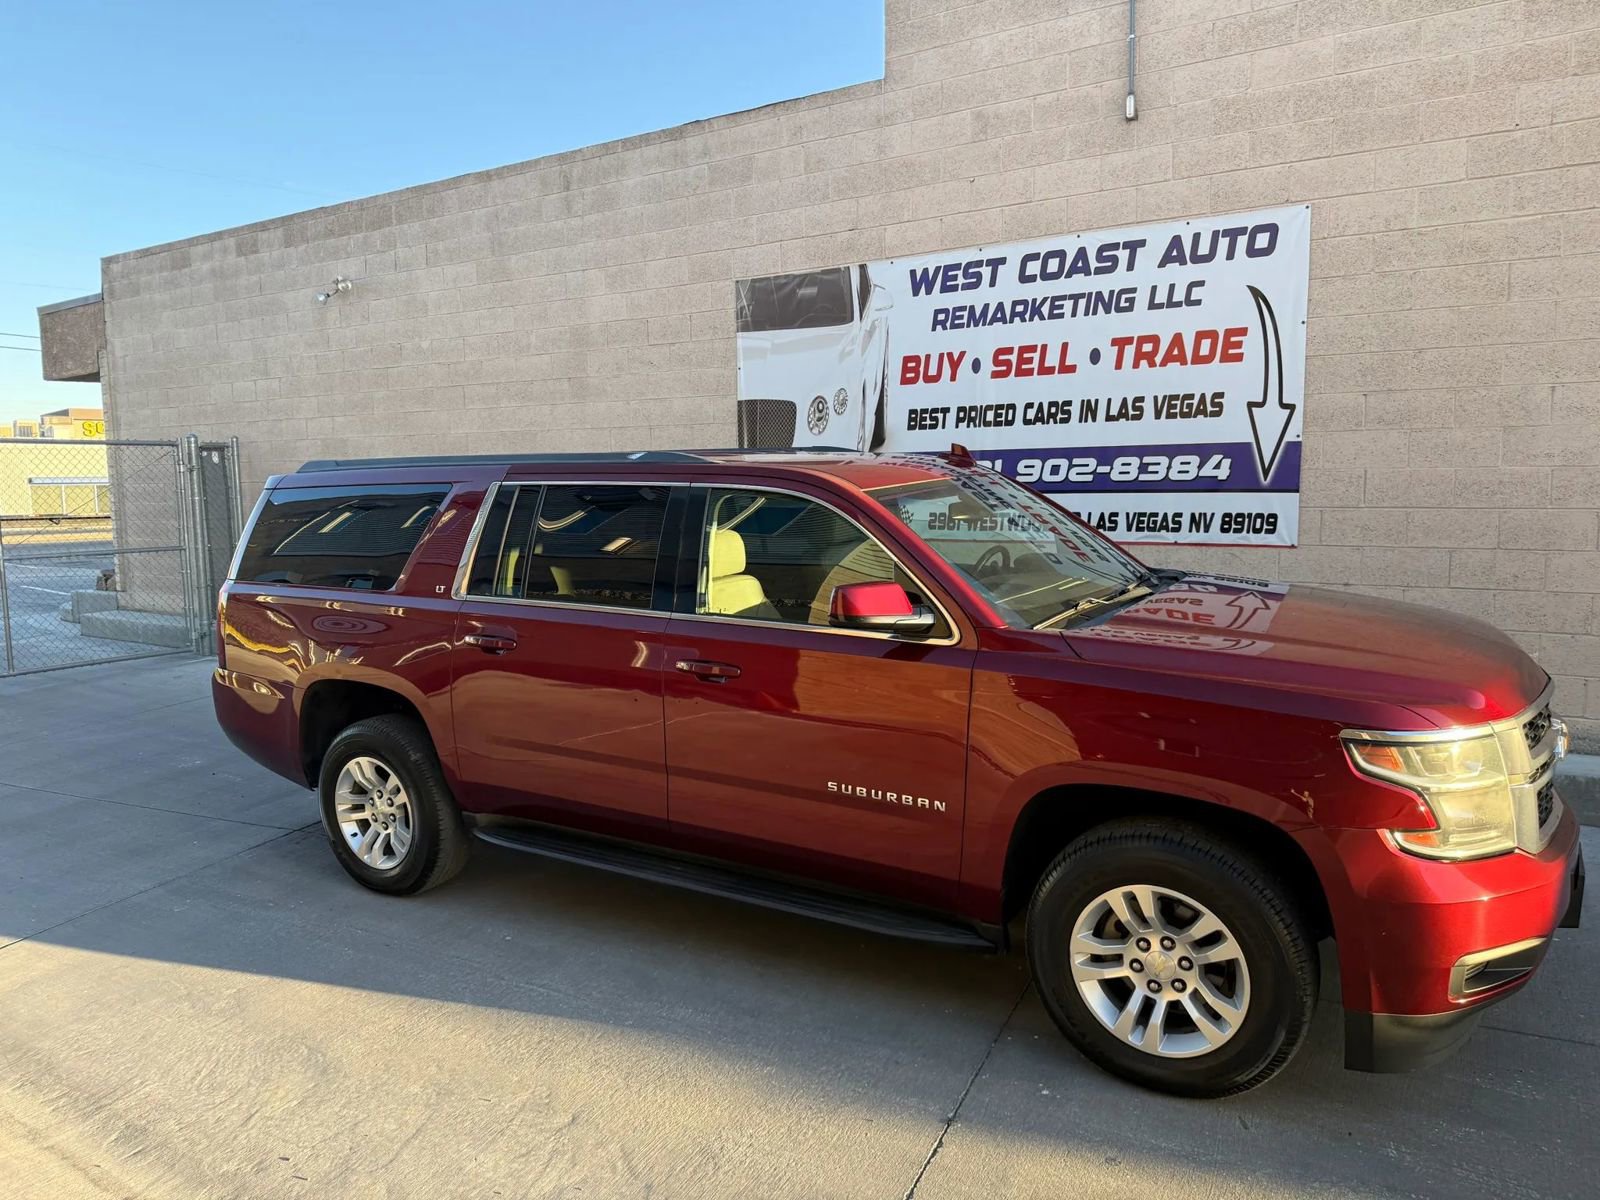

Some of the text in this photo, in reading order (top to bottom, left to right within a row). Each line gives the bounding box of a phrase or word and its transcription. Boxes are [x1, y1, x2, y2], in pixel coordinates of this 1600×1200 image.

[909, 222, 1280, 297] WEST COAST AUTO
[930, 280, 1206, 332] REMARKETING LLC
[899, 326, 1249, 386] BUY SELL TRADE
[906, 391, 1226, 431] BEST PRICED CARS IN LAS VEGAS
[1015, 454, 1232, 483] 902-8384
[1087, 512, 1119, 532] LAS
[1125, 512, 1183, 533] VEGAS
[1188, 512, 1215, 533] NV
[1220, 511, 1279, 534] 89109
[435, 585, 446, 593] LT
[827, 781, 946, 812] SUBURBAN
